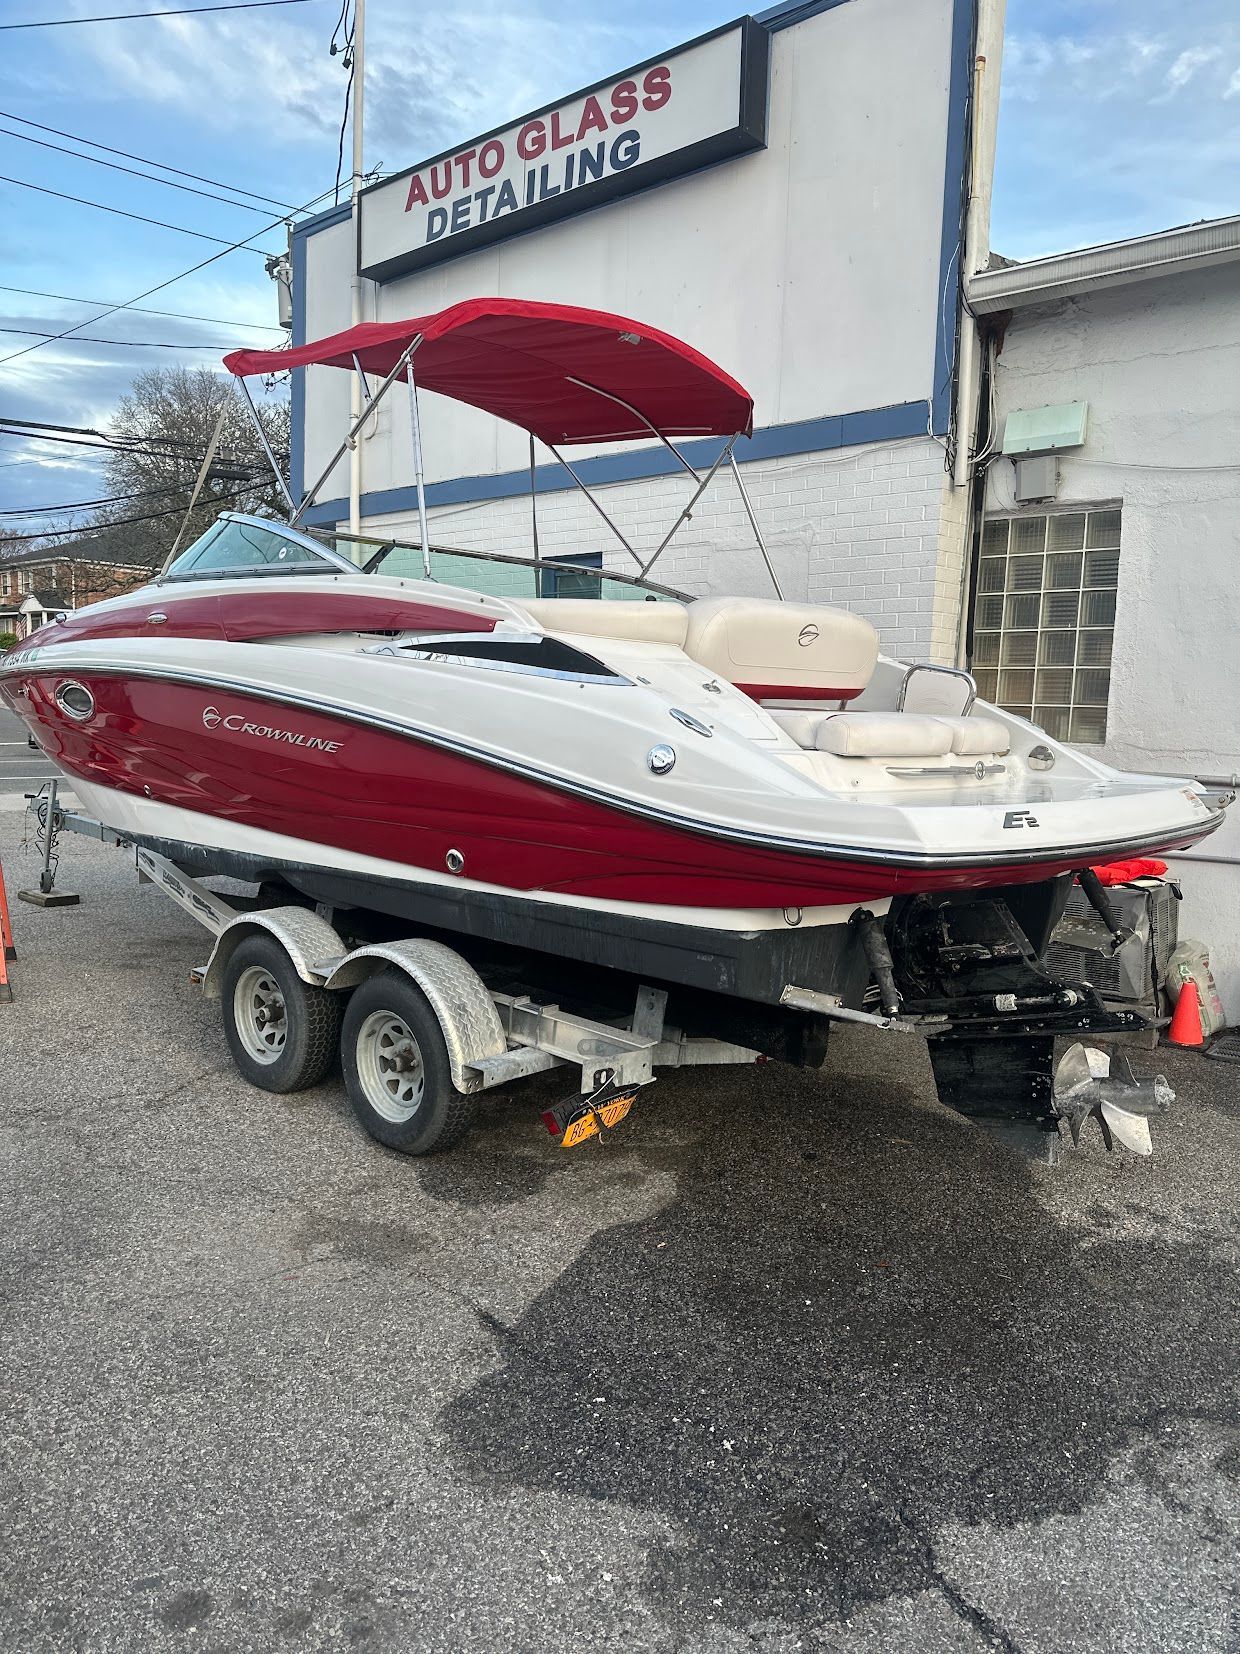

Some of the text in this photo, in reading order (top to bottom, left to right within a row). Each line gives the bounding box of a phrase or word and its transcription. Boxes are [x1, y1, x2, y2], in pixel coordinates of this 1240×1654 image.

[404, 66, 672, 213] AUTO GLASS
[425, 129, 641, 243] DETAILING
[222, 714, 345, 753] CROWNLINE
